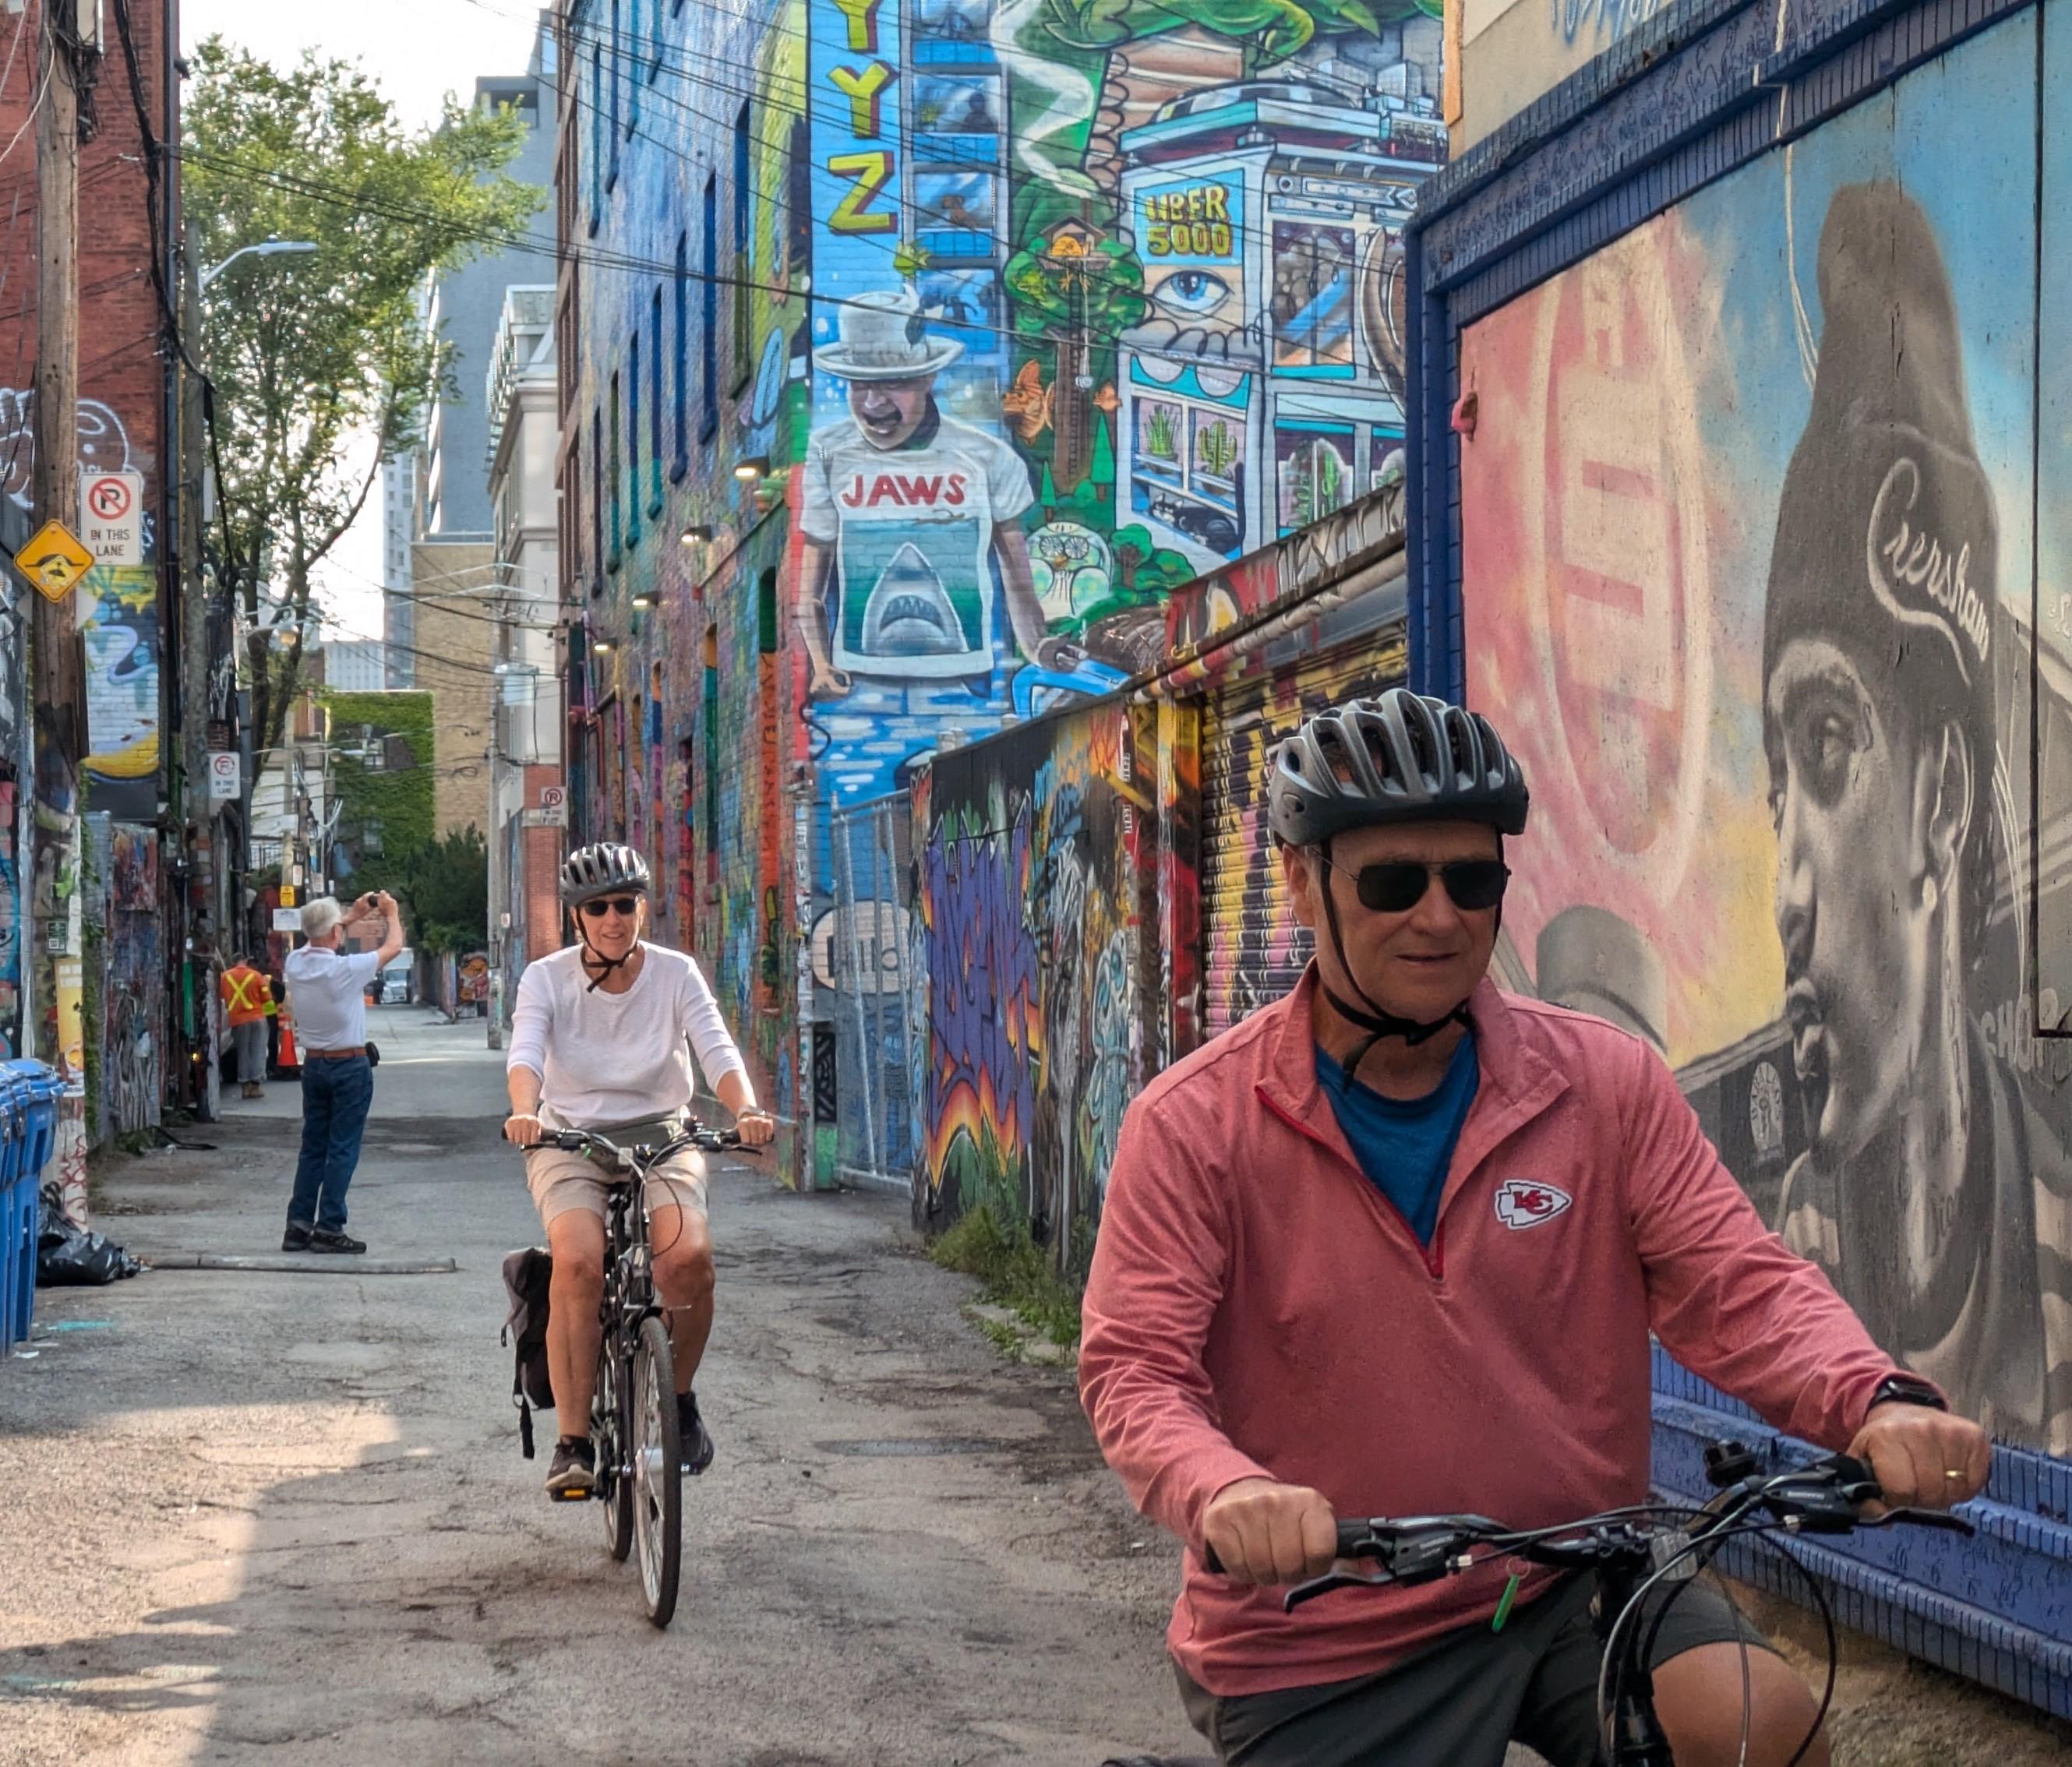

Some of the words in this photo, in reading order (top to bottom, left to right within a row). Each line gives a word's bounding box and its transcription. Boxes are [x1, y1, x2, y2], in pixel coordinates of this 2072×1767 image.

[1145, 185, 1230, 221] UBER
[1147, 222, 1233, 256] 5000
[842, 474, 967, 508] JAWS
[96, 545, 125, 556] LANE
[106, 529, 130, 540] THIS
